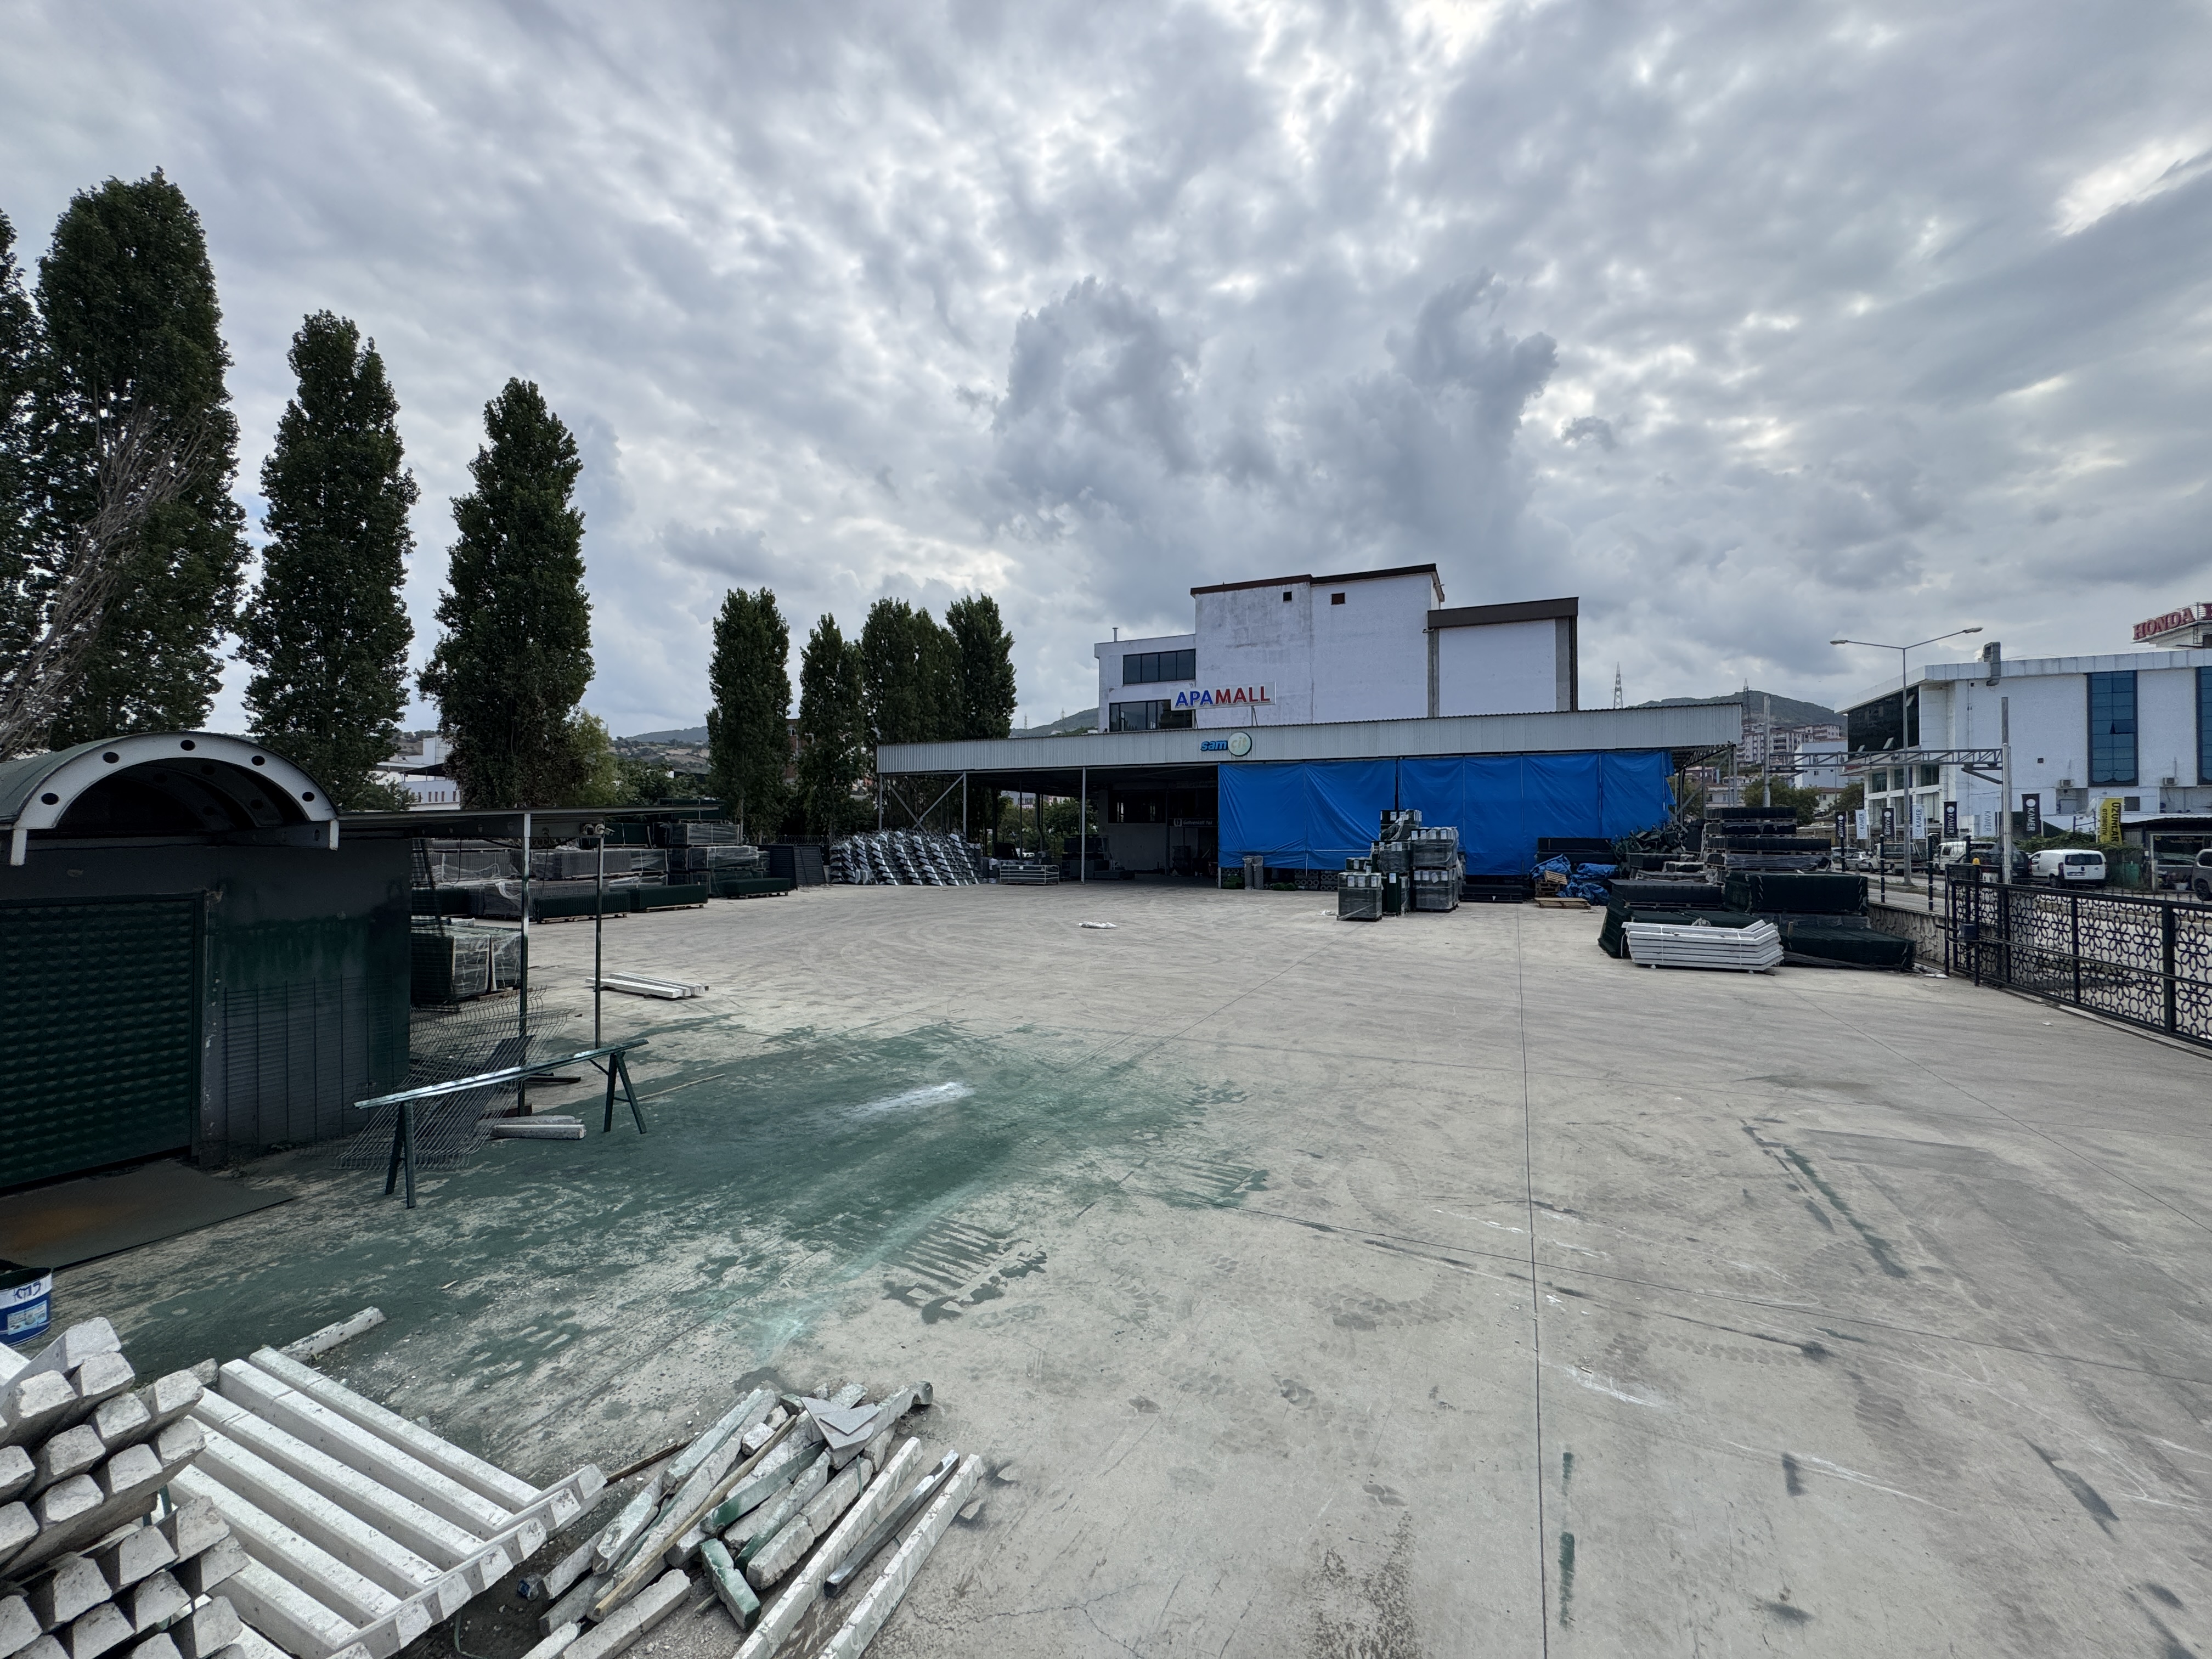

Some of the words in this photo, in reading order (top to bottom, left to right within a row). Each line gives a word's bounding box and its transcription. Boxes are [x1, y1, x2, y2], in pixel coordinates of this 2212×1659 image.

[2133, 607, 2195, 640] HONDA
[1175, 686, 1271, 707] APAMALL
[2027, 808, 2035, 831] KAMER
